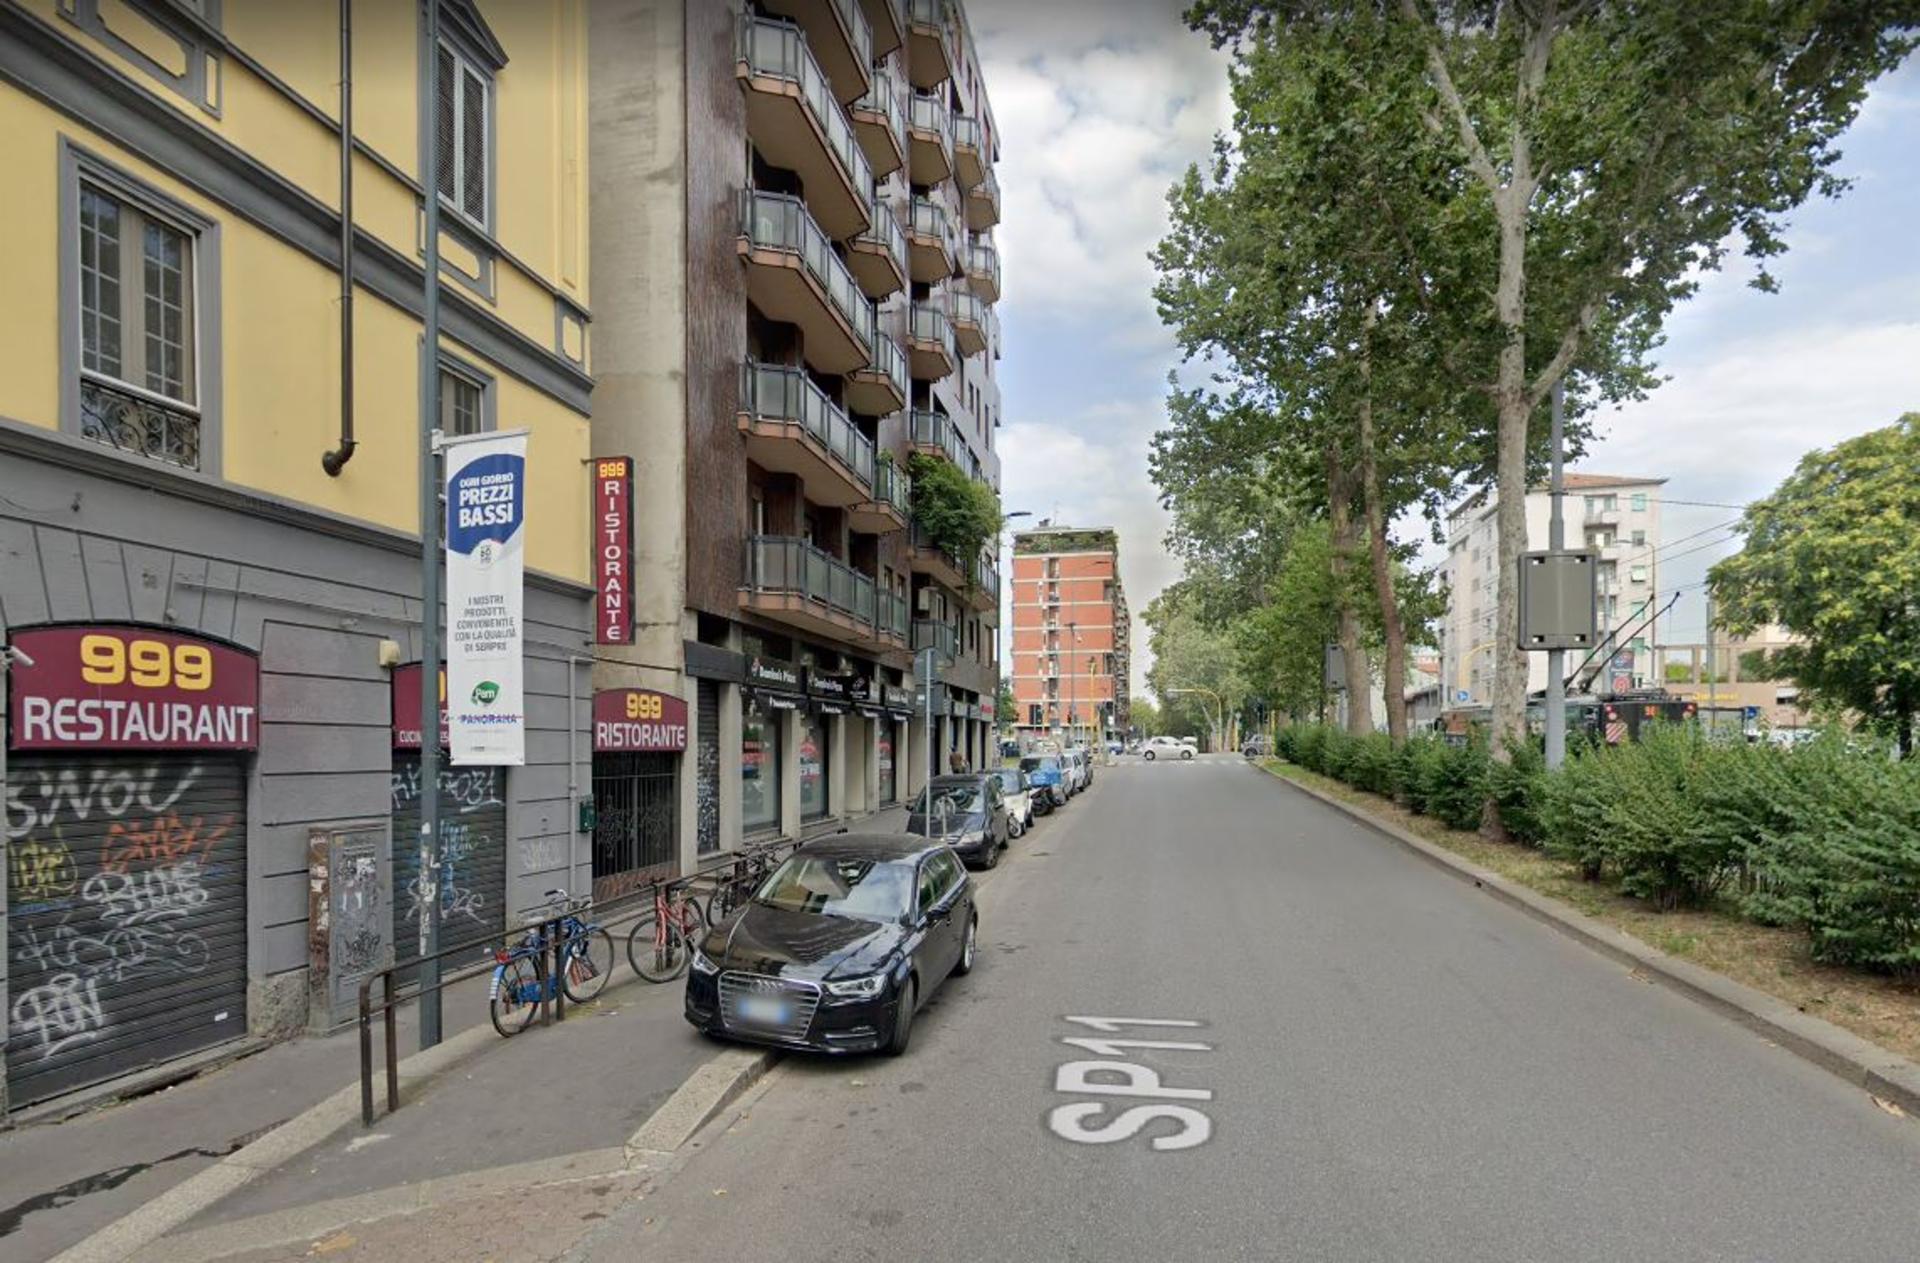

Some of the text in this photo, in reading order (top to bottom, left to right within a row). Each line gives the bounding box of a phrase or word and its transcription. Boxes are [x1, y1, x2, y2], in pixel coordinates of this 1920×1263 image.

[599, 462, 625, 478] 999
[459, 483, 514, 507] PREZZI
[459, 502, 514, 528] BASSI
[605, 480, 621, 640] RISTORANTE
[80, 635, 212, 690] 999
[475, 687, 495, 699] Pam
[627, 693, 662, 719] 999
[24, 696, 254, 742] RESTAURANT
[459, 714, 517, 725] PANORAMA
[597, 722, 685, 747] RISTORANTE
[1050, 1015, 1212, 1150] SP11
